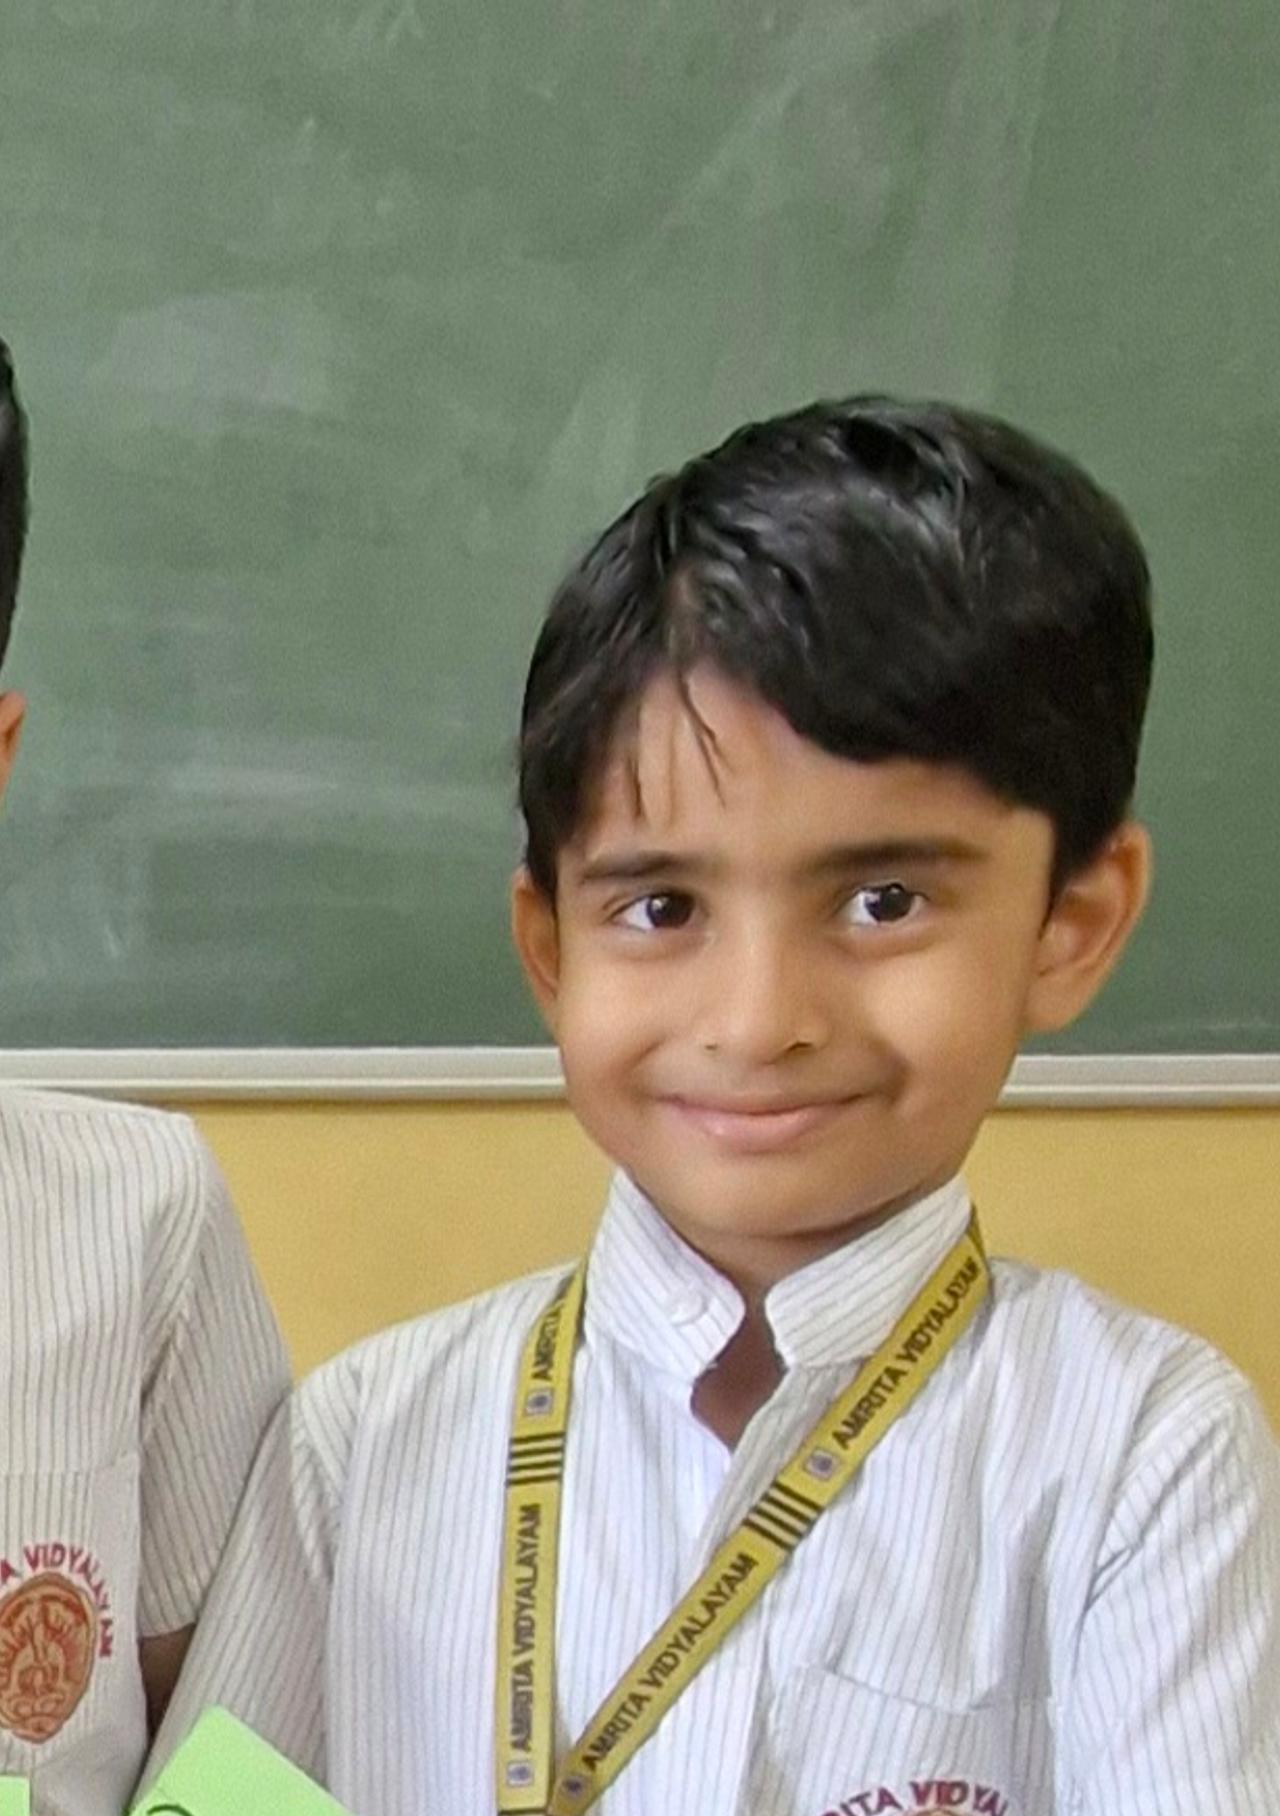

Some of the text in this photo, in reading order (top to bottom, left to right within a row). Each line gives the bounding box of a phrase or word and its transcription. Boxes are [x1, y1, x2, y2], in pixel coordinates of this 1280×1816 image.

[832, 1366, 909, 1450] AMRITA
[510, 1503, 540, 1752] AMRITA VIDYALAYAM
[581, 1553, 759, 1772] AMRITA VIDYALAYAM
